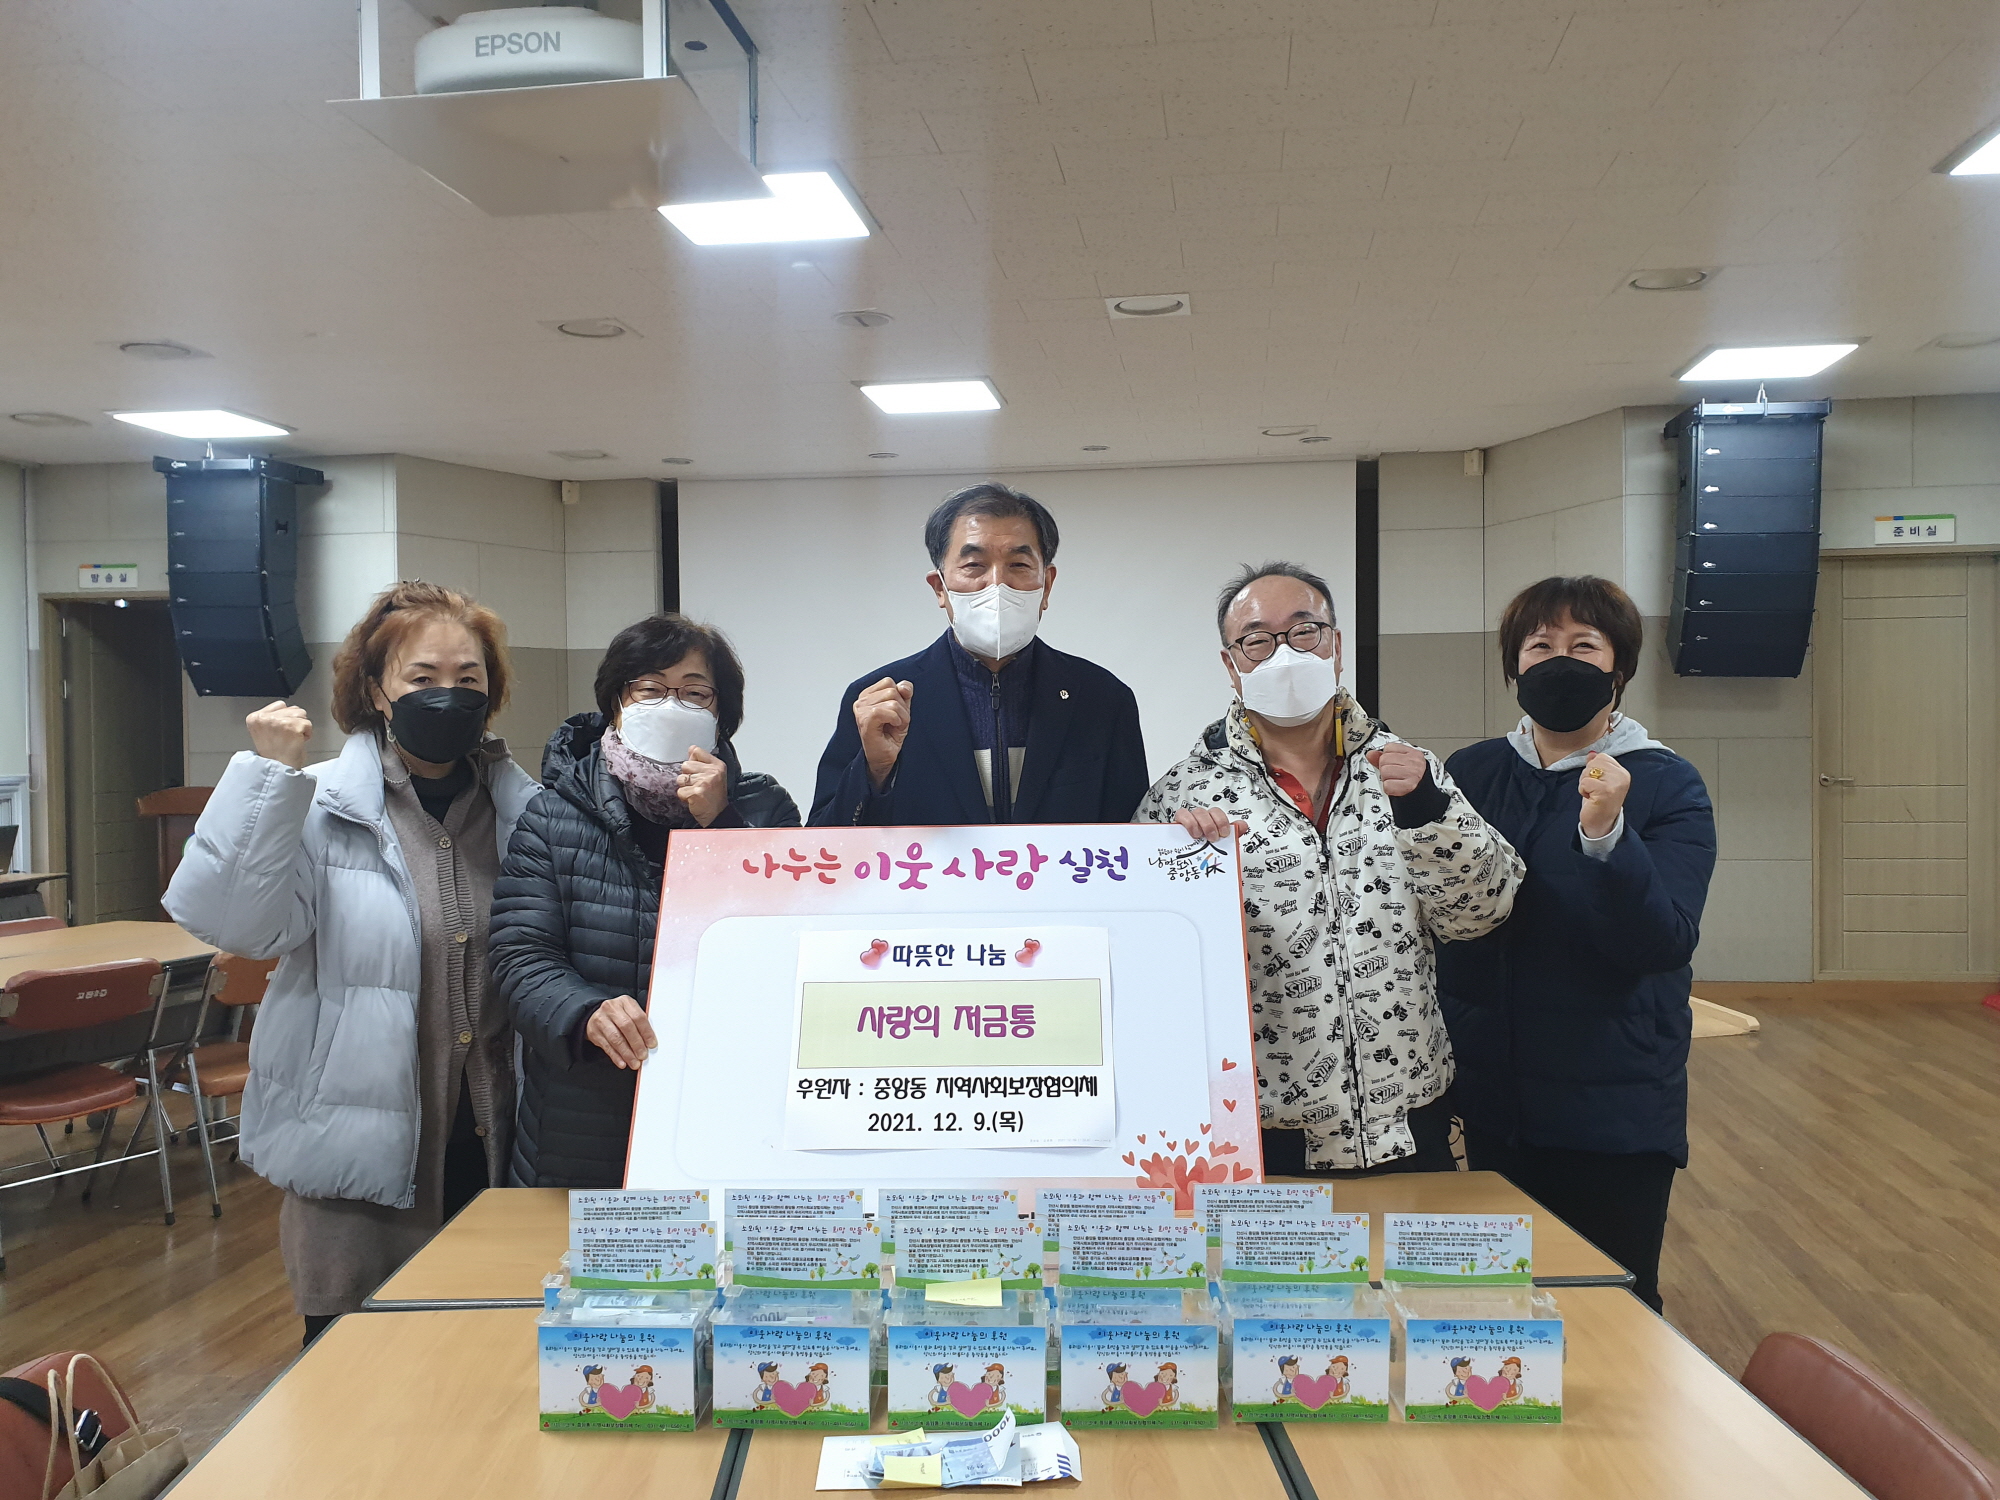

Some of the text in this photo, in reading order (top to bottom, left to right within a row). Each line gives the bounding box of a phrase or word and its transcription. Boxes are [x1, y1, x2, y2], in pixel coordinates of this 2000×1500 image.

[475, 31, 561, 58] EPSON
[1893, 525, 1937, 537] 준비실
[743, 842, 1128, 890] 나누는 이웃 사랑 실천
[1265, 853, 1301, 873] SUPER
[1167, 866, 1201, 882] 중앙동
[1274, 899, 1297, 912] Indigo
[893, 943, 1007, 967] 따뜻한 나눔
[1353, 955, 1389, 979] SUPER
[1284, 975, 1322, 999] SUPER
[857, 1004, 1036, 1039] 사랑의 저금통
[1292, 1026, 1316, 1039] Indigo
[1299, 1032, 1316, 1044] Bank
[1307, 1052, 1339, 1087] SUPER
[796, 1078, 851, 1100] 후원자
[874, 1077, 927, 1100] 중앙동
[935, 1075, 1098, 1099] 지역사회보장협의체
[867, 1110, 1024, 1133] 2021. 12. 9.(목)
[1302, 1103, 1339, 1124] SUPER
[611, 1333, 635, 1343] 나눔의
[639, 1333, 655, 1342] 후원
[786, 1330, 811, 1340] 나눔의
[815, 1330, 832, 1340] 후원
[962, 1331, 987, 1340] 나눔의
[991, 1331, 1007, 1340] 후원
[1135, 1331, 1159, 1340] 나눔의
[1164, 1331, 1180, 1340] 후원
[1306, 1324, 1332, 1334] 나눔의
[1335, 1324, 1352, 1333] 후원
[1479, 1325, 1504, 1335] 나눔의
[1508, 1325, 1524, 1334] 후원
